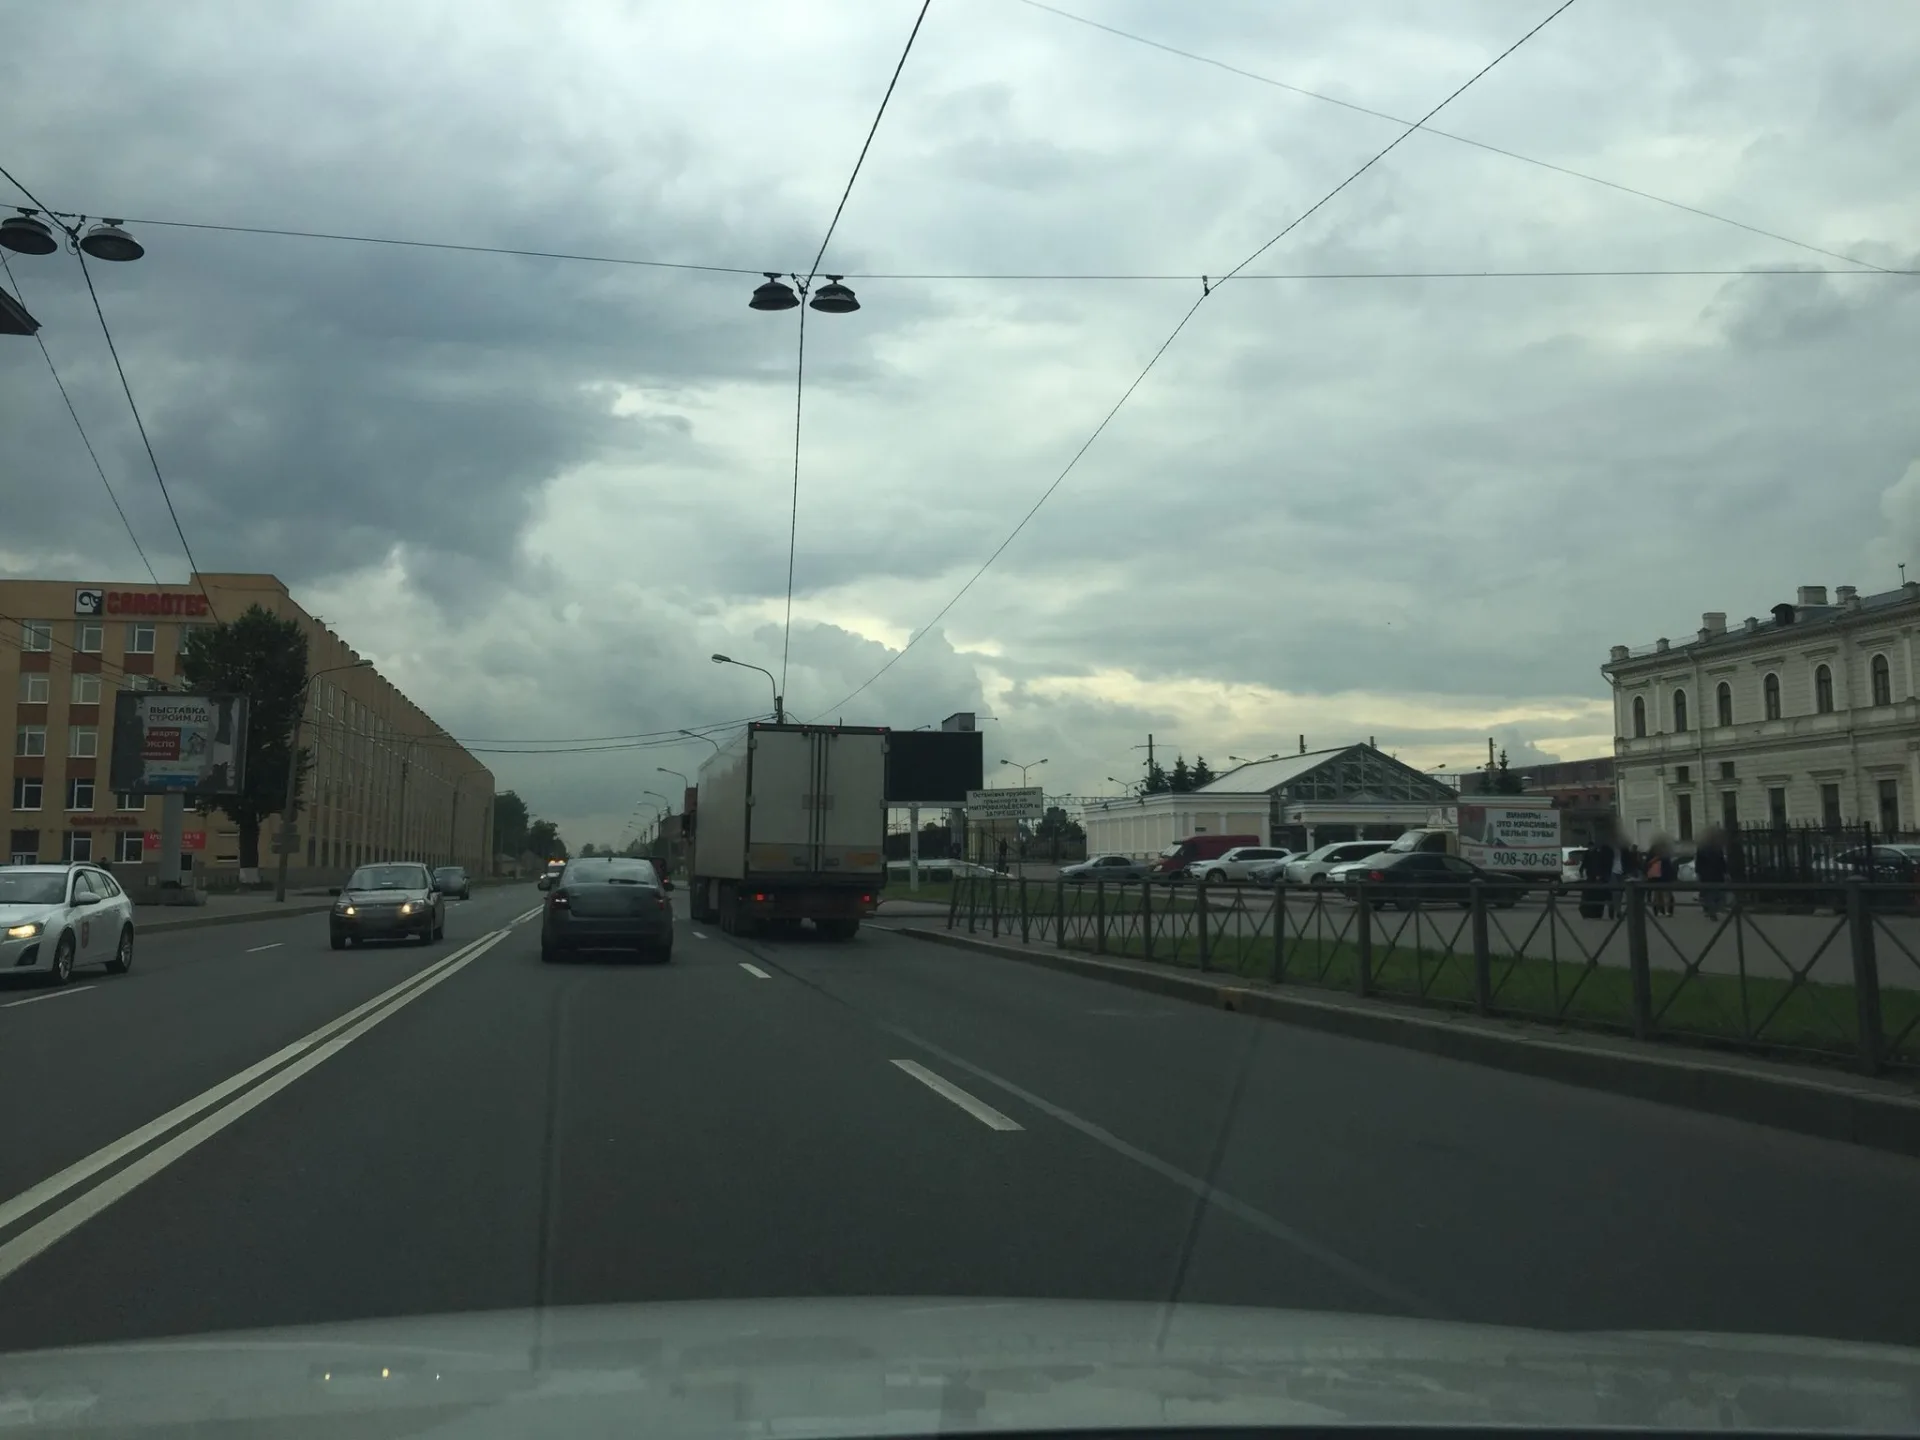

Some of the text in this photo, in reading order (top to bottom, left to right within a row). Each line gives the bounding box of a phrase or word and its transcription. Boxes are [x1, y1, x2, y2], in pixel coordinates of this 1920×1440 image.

[150, 706, 205, 714] ВЫСТАВКА
[1513, 821, 1557, 829] КРАСИВЫЕ
[1500, 829, 1554, 838] БЕЛЫЕ ЗУБЫ
[1493, 851, 1557, 866] 908-30-65
